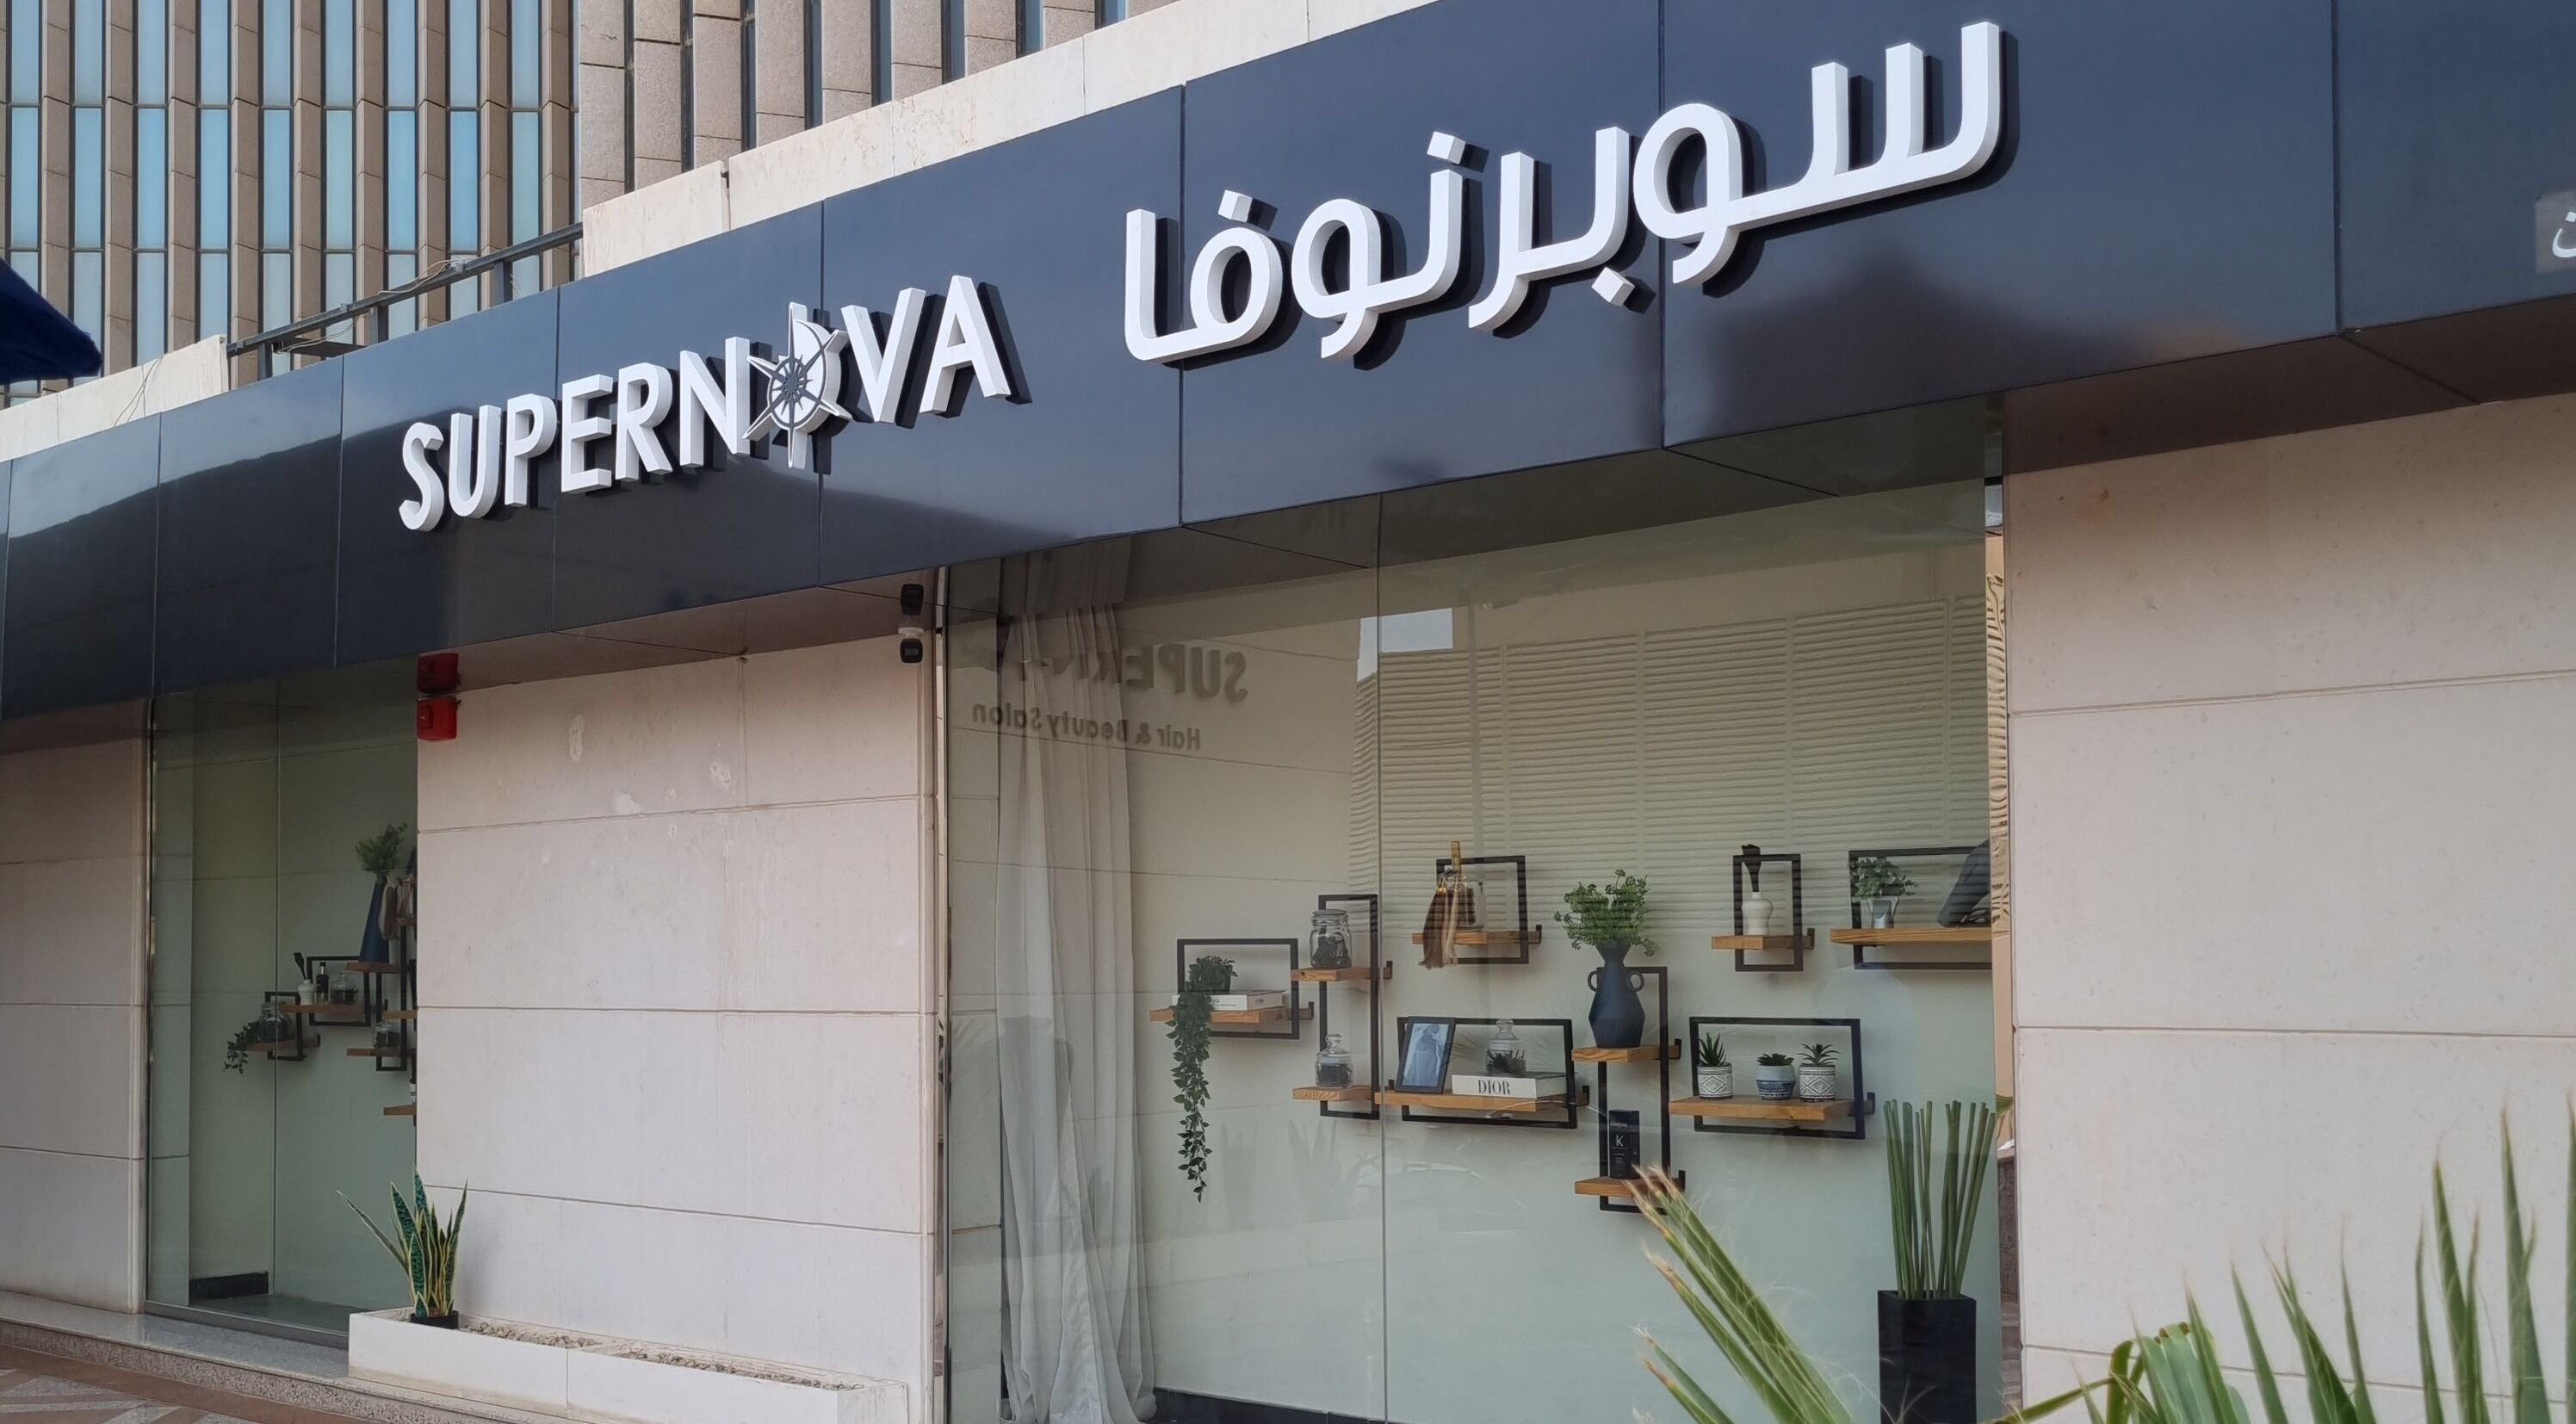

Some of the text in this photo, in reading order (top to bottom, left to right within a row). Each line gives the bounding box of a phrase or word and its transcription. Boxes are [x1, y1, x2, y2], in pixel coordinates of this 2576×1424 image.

[1124, 21, 2001, 362] سوبرنوفا
[399, 275, 1011, 532] SUPERNOVA
[1477, 1079, 1510, 1095] DIOR
[1615, 1134, 1625, 1148] K
